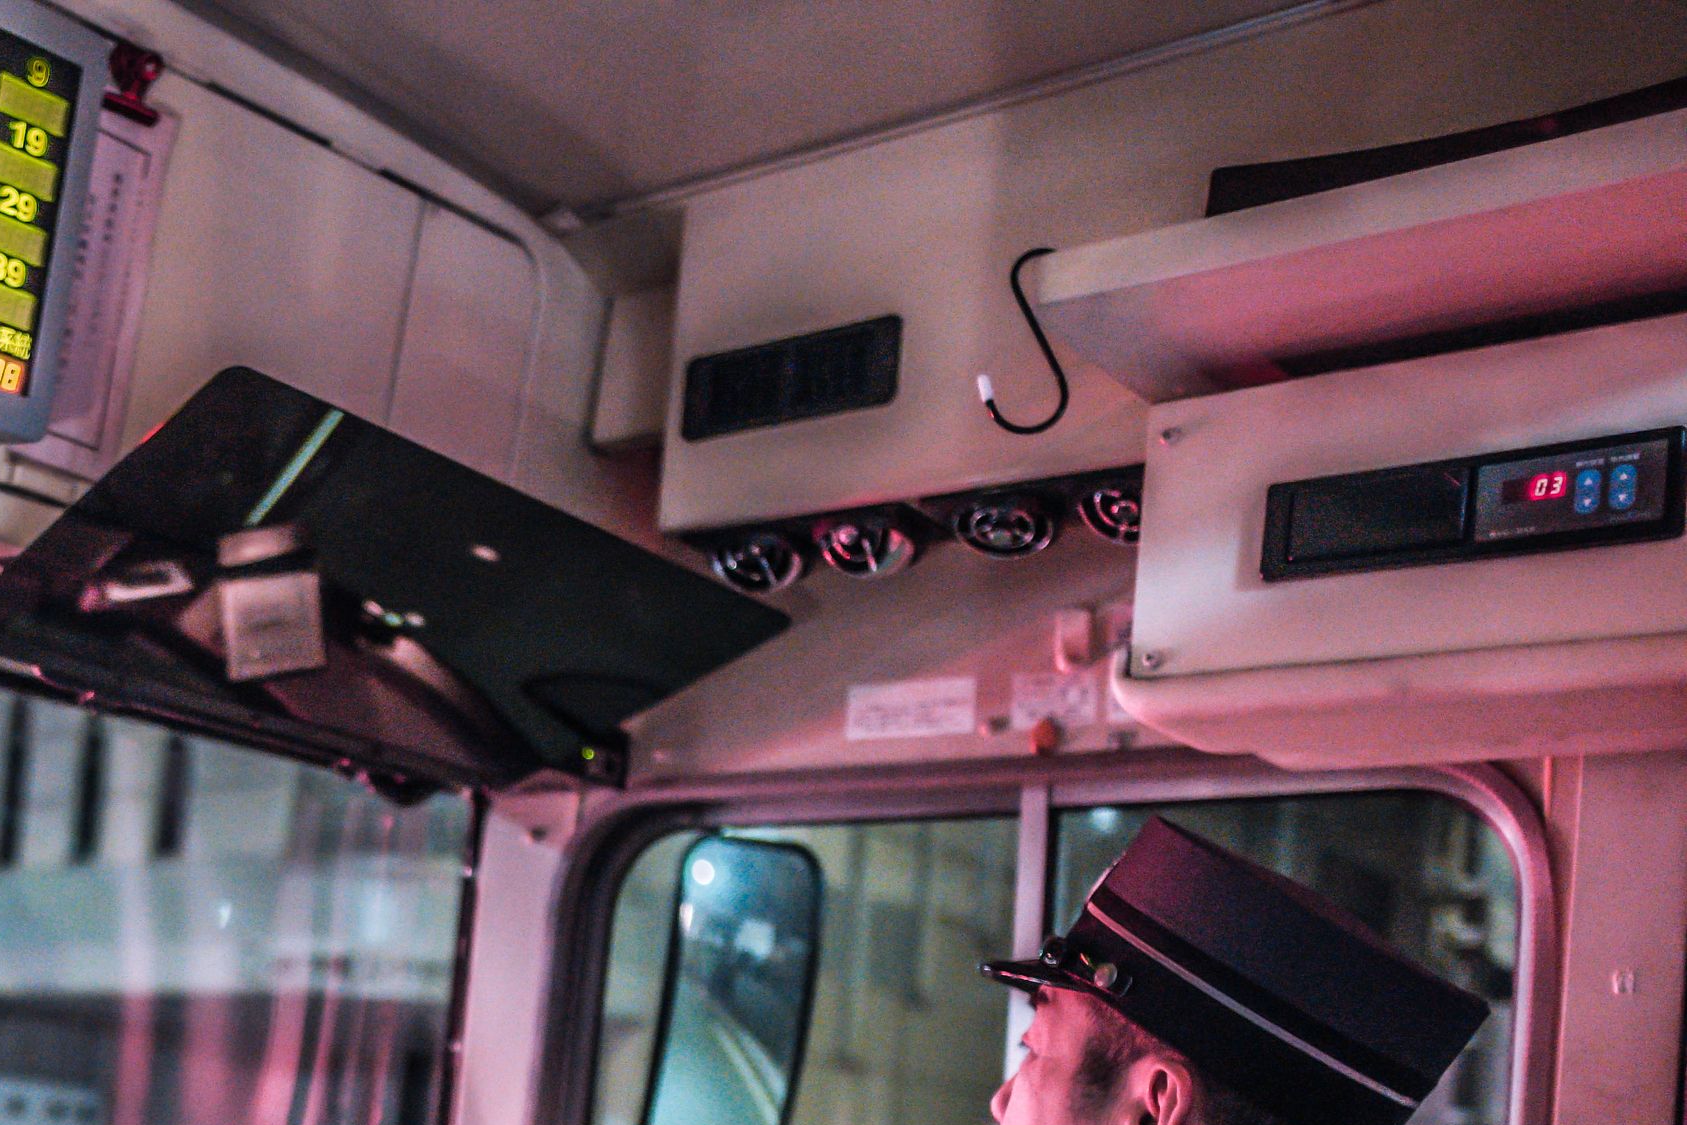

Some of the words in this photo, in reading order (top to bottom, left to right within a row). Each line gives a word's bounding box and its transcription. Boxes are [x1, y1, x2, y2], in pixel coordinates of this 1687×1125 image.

[27, 57, 51, 88] 9
[9, 121, 48, 157] 19
[1534, 475, 1564, 497] 03
